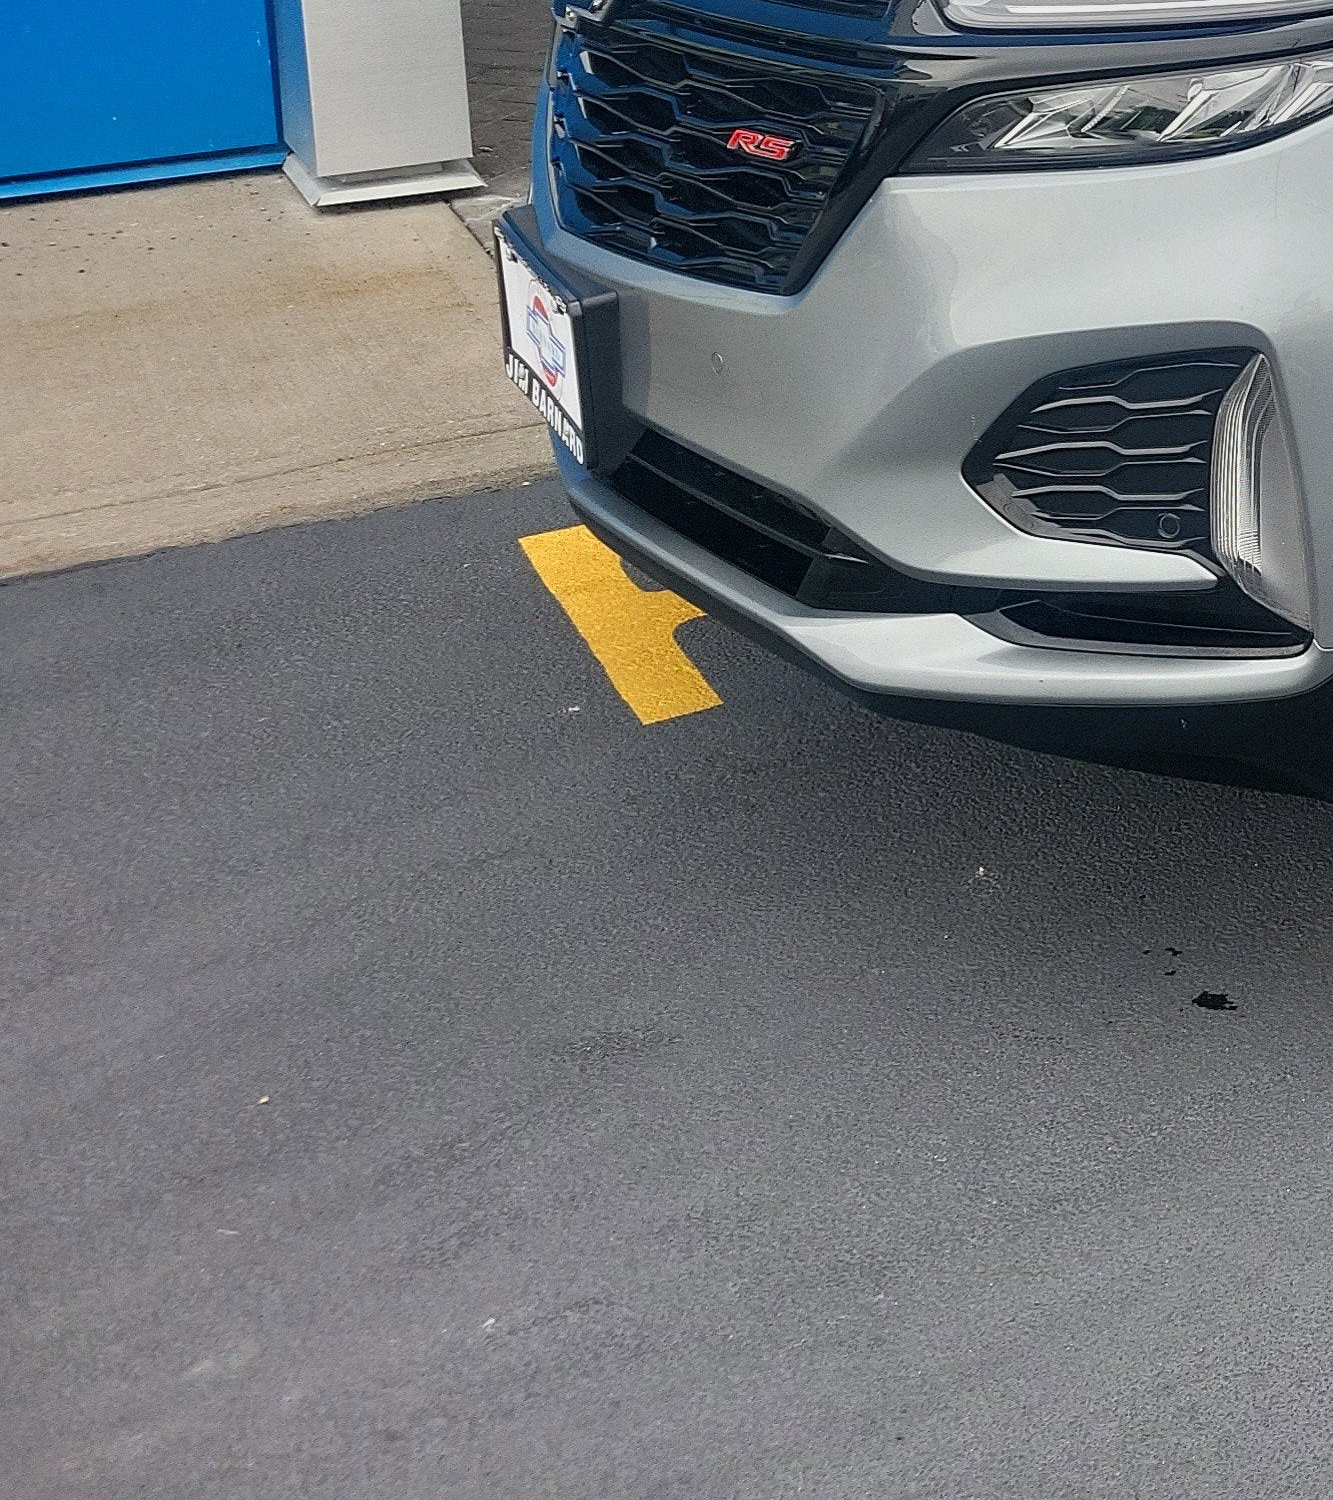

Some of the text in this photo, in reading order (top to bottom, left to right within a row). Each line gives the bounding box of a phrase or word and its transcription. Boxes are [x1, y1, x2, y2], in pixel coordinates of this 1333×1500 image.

[726, 129, 796, 161] RS
[505, 353, 529, 396] JIM
[531, 381, 584, 466] BARNARD
